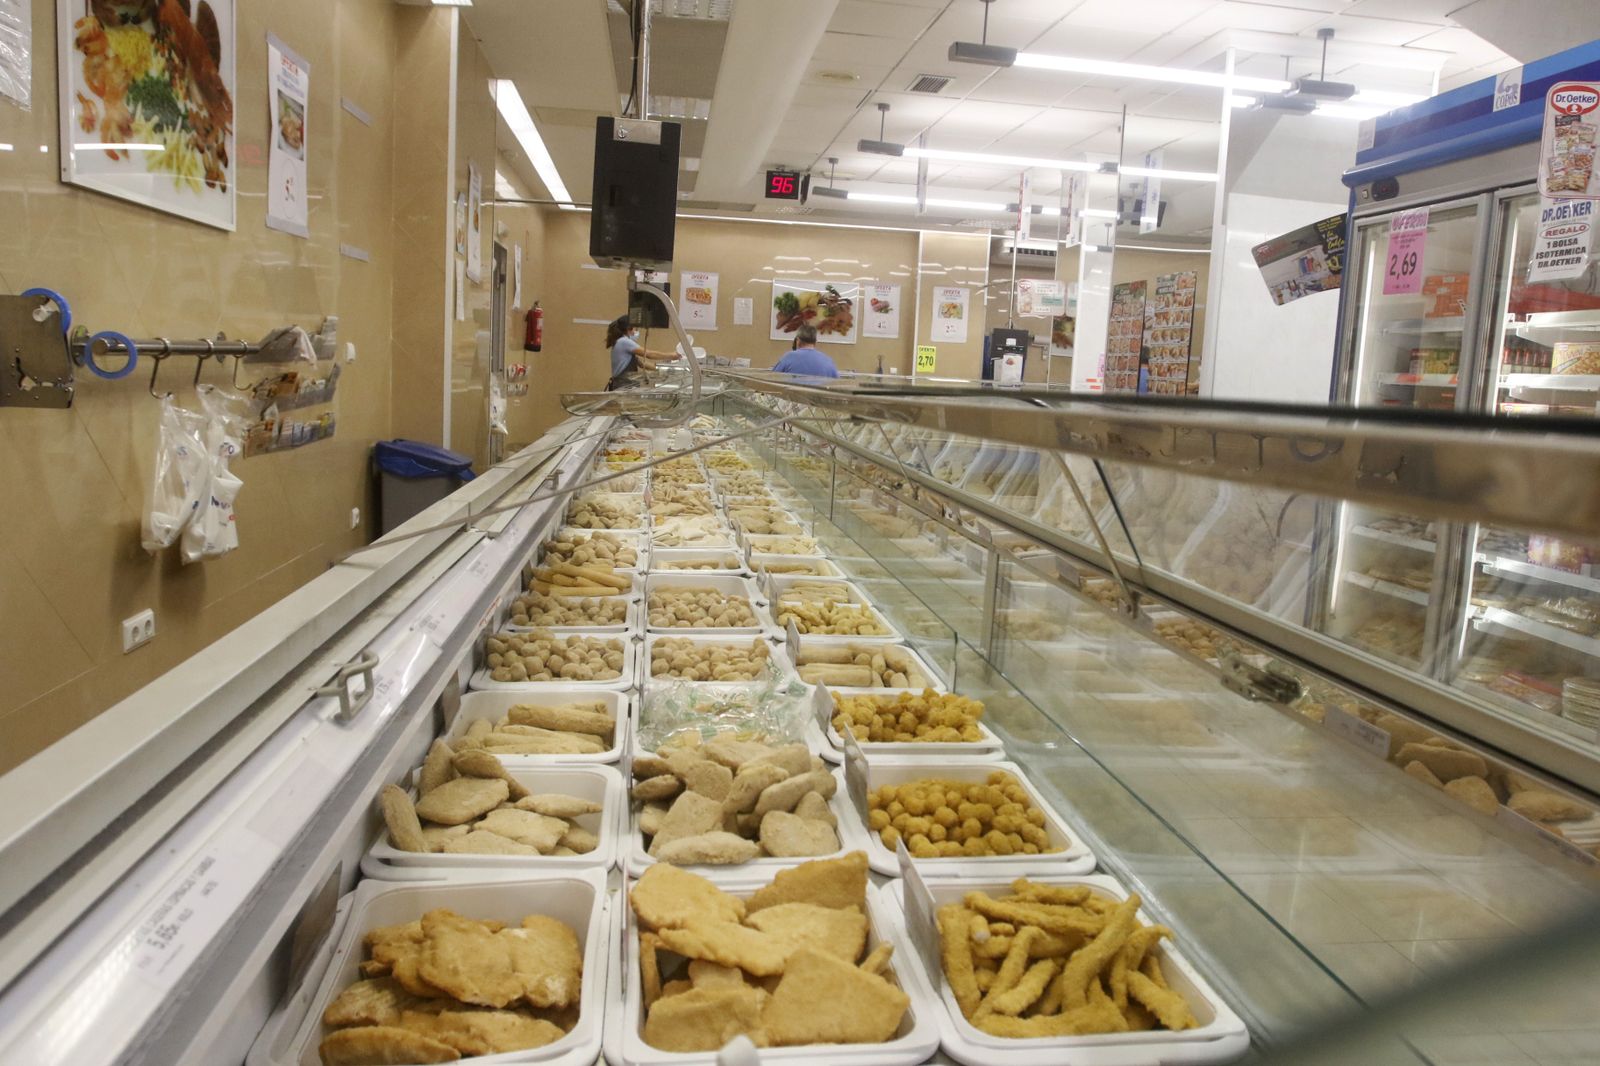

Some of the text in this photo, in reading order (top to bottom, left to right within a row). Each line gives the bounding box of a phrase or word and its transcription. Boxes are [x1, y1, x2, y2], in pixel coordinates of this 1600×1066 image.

[771, 176, 794, 193] 96
[1545, 224, 1587, 237] REGALO
[1552, 238, 1578, 248] BOLSA
[1536, 246, 1586, 259] ISOTERMICA
[1389, 251, 1417, 280] 2,69
[918, 355, 934, 368] 2,70
